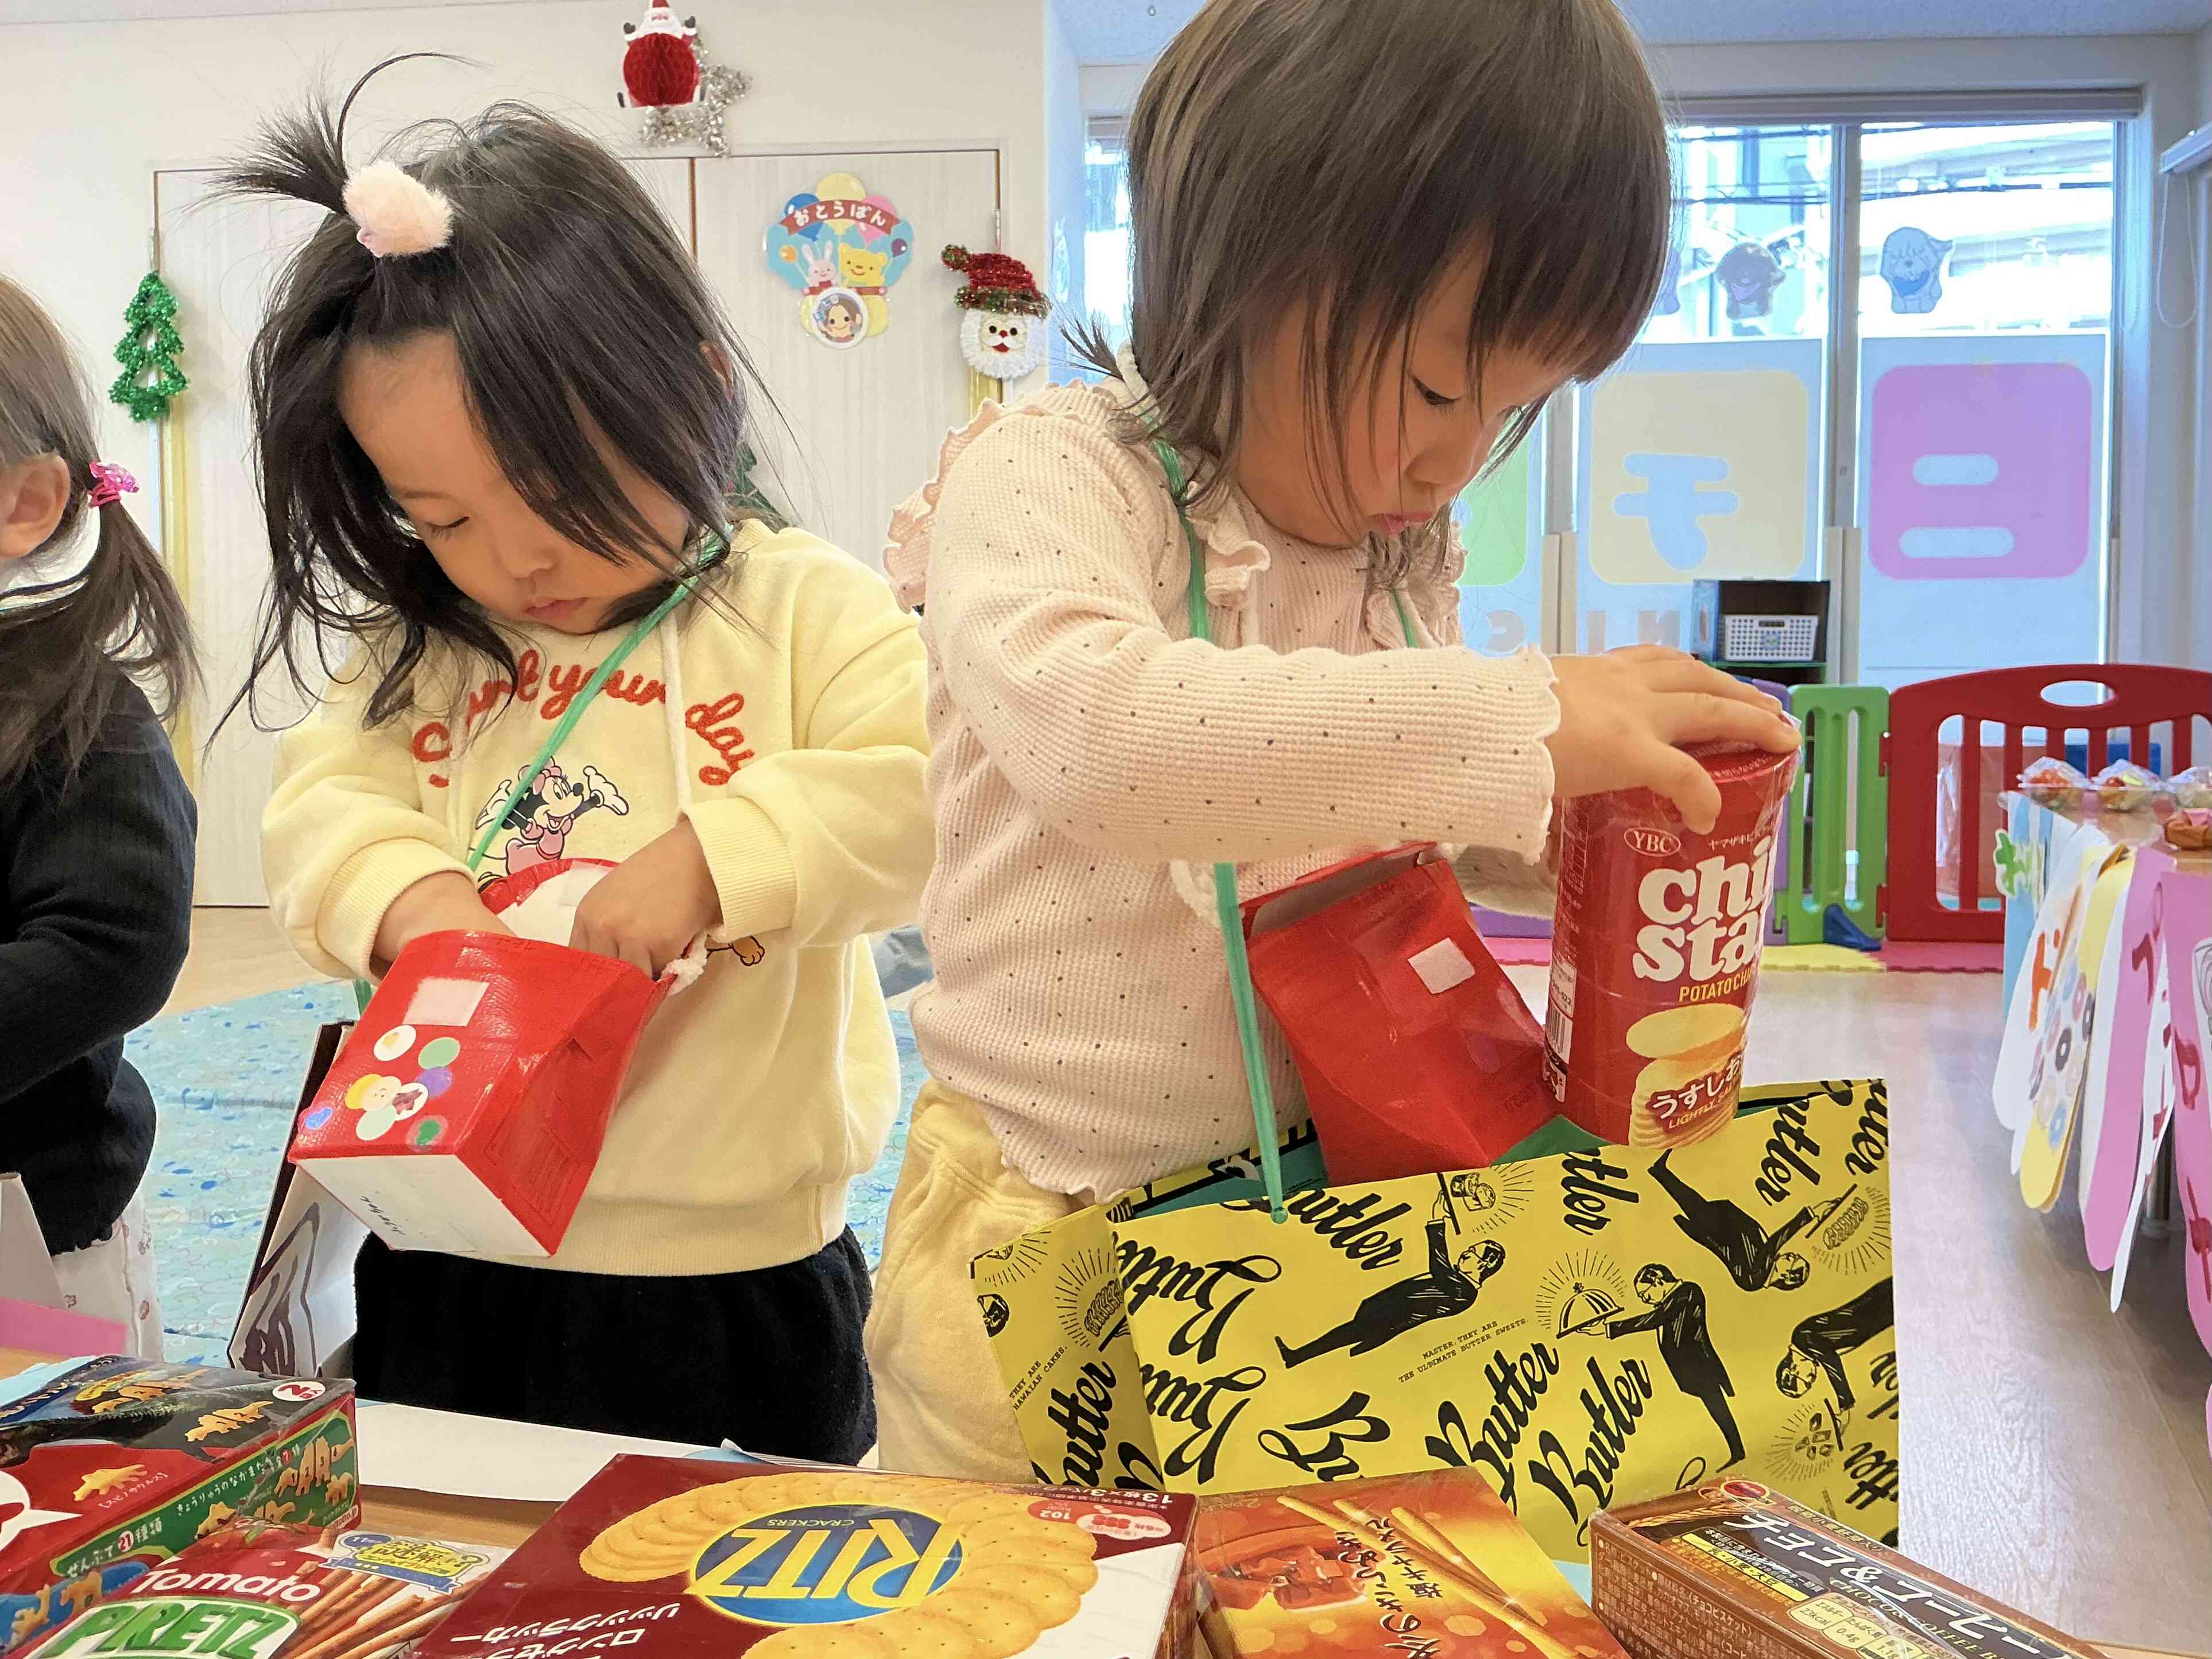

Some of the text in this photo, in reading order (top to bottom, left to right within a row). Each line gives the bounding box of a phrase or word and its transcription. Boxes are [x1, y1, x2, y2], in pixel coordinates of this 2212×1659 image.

[793, 201, 886, 227] おとうばん
[1632, 831, 1671, 854] YBC
[1679, 976, 1731, 1002] POTATO
[1668, 1100, 1717, 1129] LIGHTLY
[1457, 1329, 1479, 1343] THEY
[1481, 1321, 1498, 1333] ARE
[1044, 1346, 1068, 1374] CAKES.
[1398, 1370, 1415, 1383] THE
[1417, 1350, 1457, 1373] ULTIMATE
[1460, 1333, 1493, 1352] BUTTER
[1009, 1360, 1041, 1399] THEY ARE
[1424, 1342, 1560, 1517] Butter
[1528, 1355, 1653, 1546] Butler
[766, 1519, 855, 1528] CRACKERS
[1040, 1510, 1071, 1520] 102
[685, 1518, 966, 1608] RITZ
[1365, 1518, 1443, 1599] 塩キャラメル
[129, 1567, 321, 1602] Tomato
[1334, 1532, 1442, 1659] 冬のきらめき
[1722, 1511, 2072, 1659] チョコ&コーヒー
[36, 1602, 290, 1659] PRETZ
[451, 1602, 680, 1645] リッツクラッカー
[1799, 1607, 1833, 1626] 23kcal
[1837, 1627, 1860, 1644] 0.4g
